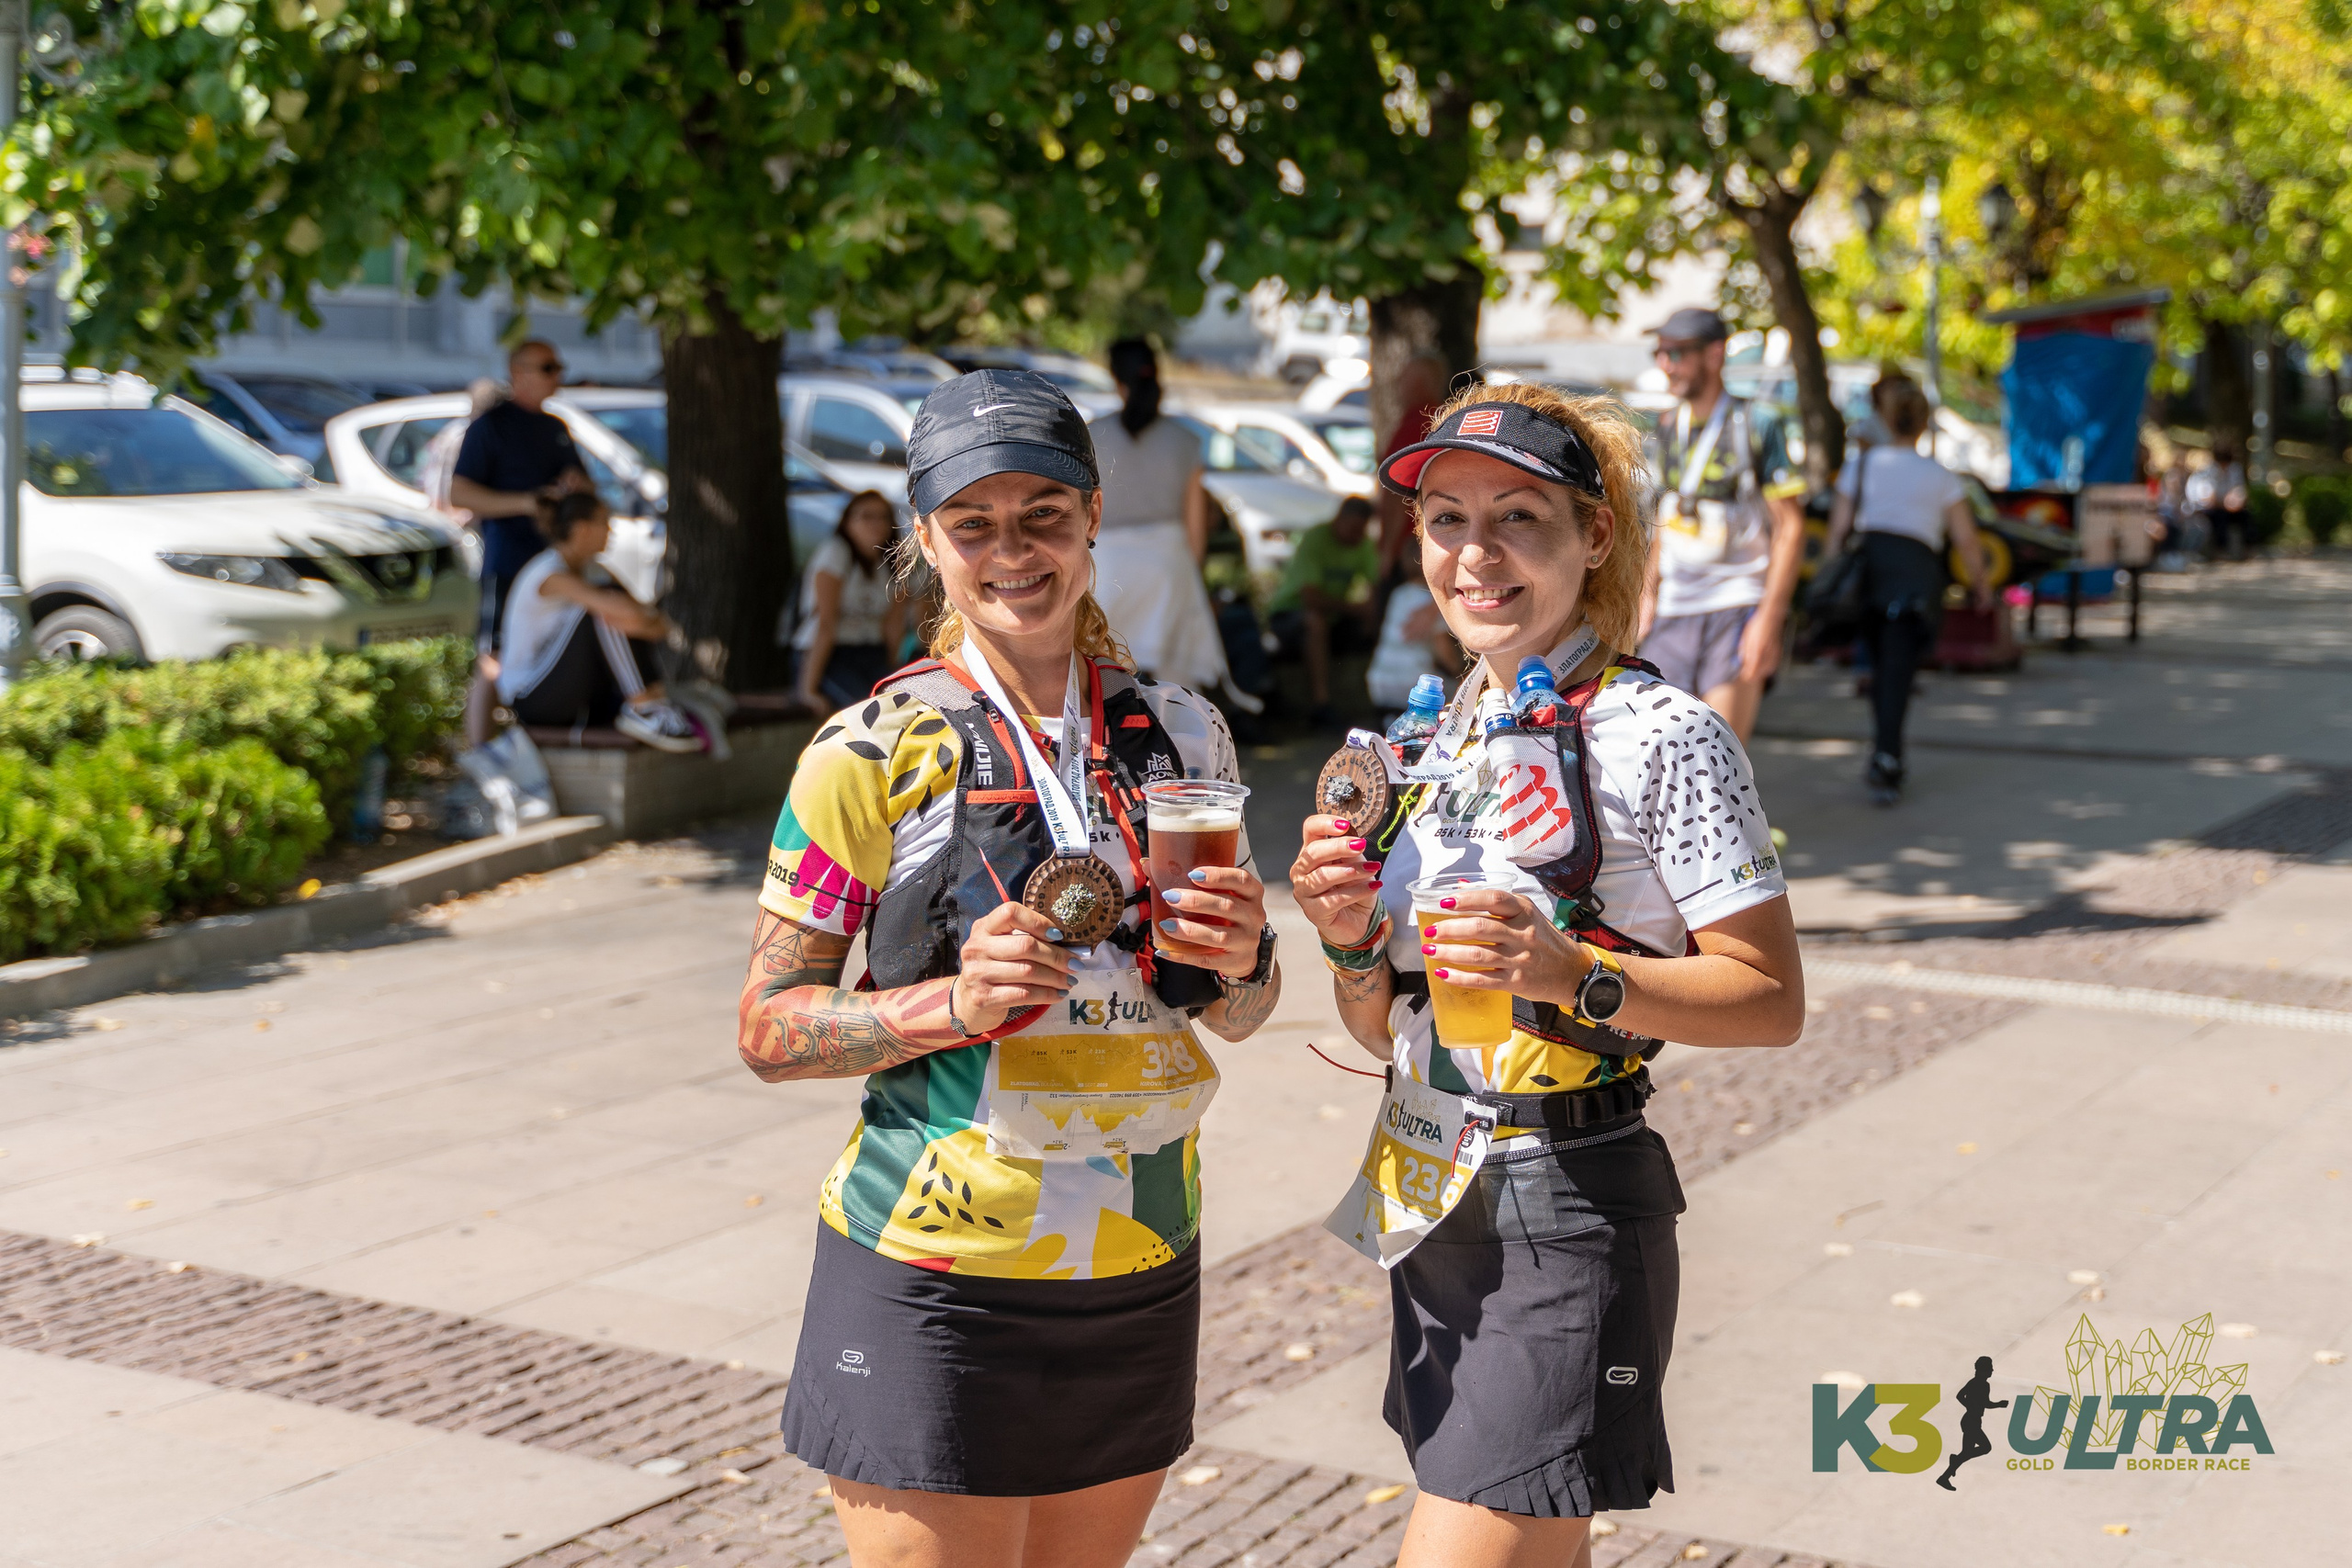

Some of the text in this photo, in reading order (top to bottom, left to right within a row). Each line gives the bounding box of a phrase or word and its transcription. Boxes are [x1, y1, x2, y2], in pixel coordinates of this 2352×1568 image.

[1558, 641, 1591, 673] ЗЛАТОГРАД
[1350, 756, 1372, 779] ULTRA
[1037, 777, 1054, 809] ЗЛАТОГРАД
[1047, 807, 1059, 821] 2019
[772, 862, 800, 887] 2019
[1047, 867, 1101, 884] K3 ULTRA
[1730, 854, 1777, 884] K3 ULTRA
[1069, 999, 1105, 1025] K3
[1141, 1039, 1197, 1078] 328
[1386, 1100, 1399, 1128] K3
[1401, 1111, 1442, 1144] ULTRA
[836, 1361, 871, 1378] Kalenji
